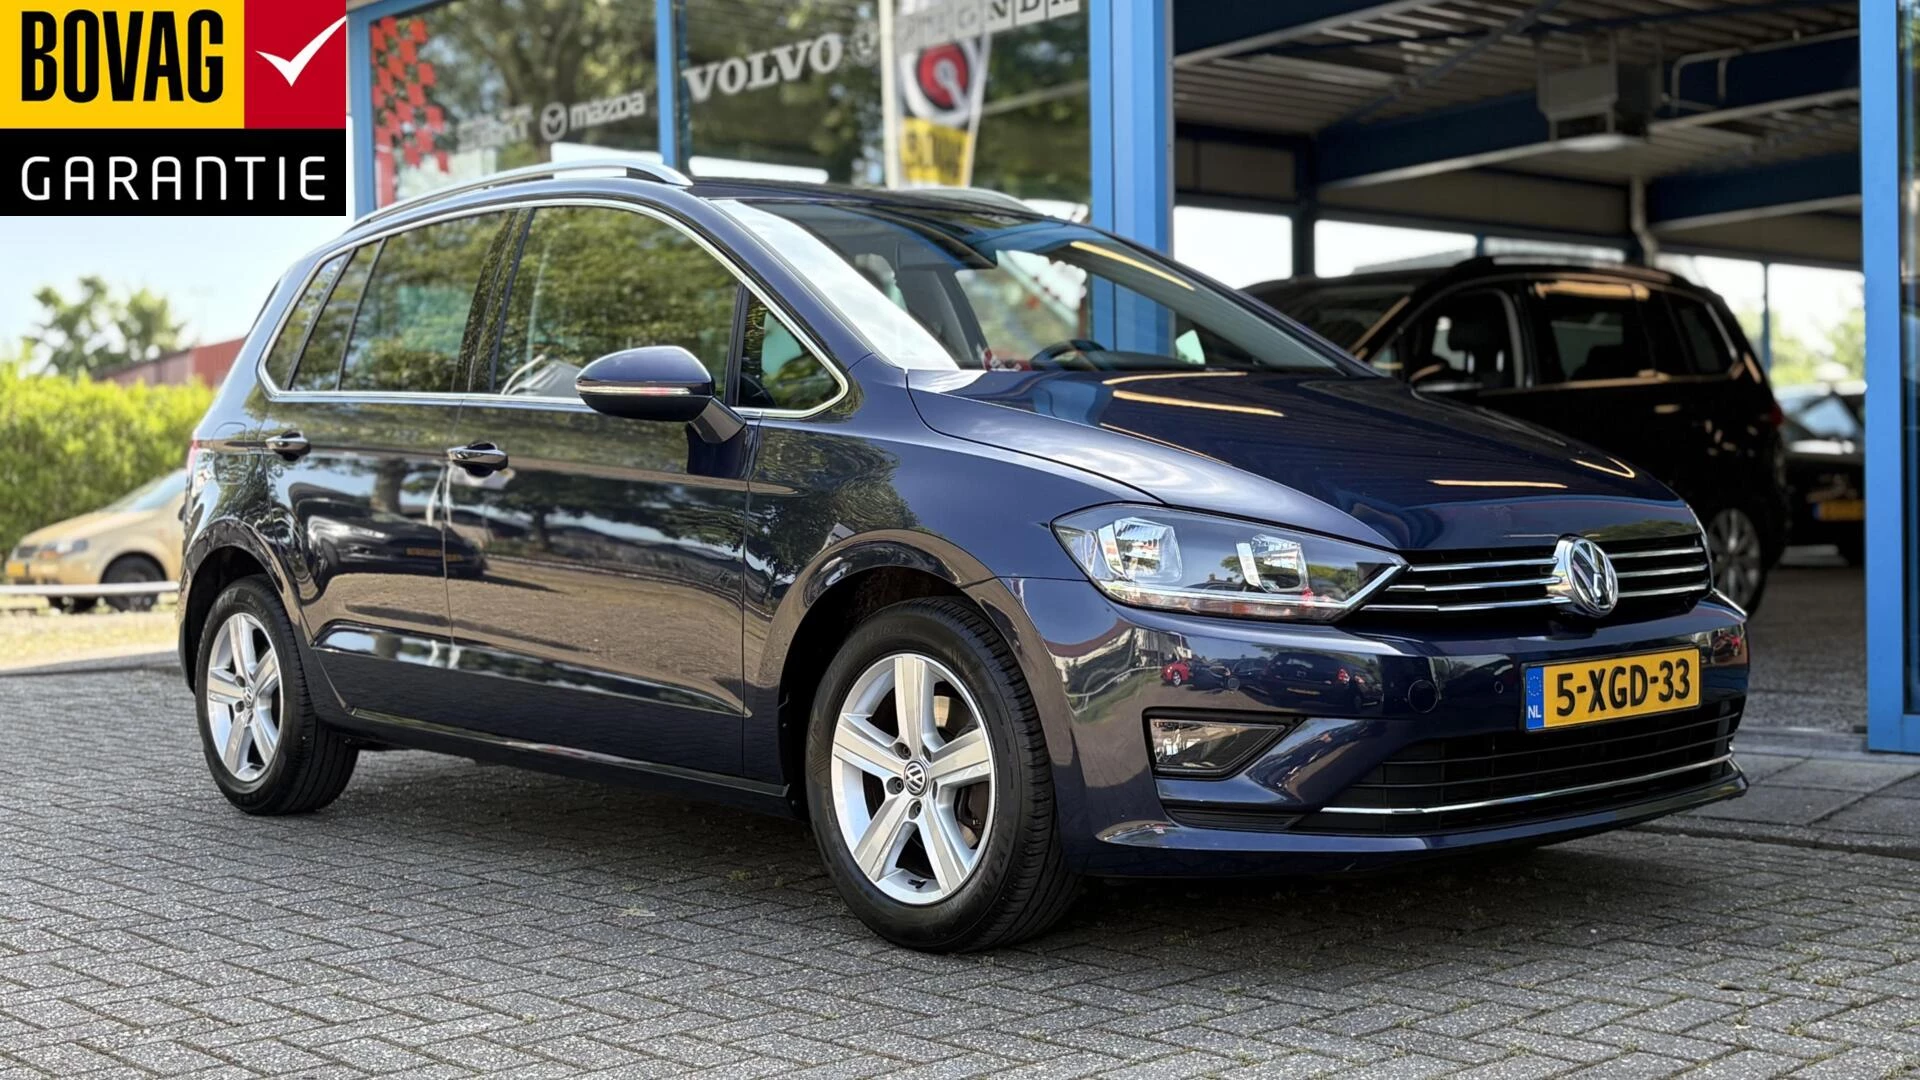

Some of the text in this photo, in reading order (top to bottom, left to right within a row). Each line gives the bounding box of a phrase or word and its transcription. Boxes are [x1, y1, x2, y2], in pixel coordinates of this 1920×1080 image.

[682, 33, 842, 101] VOLVO
[1527, 704, 1542, 719] NL
[1556, 658, 1691, 717] 5-XGD-33
